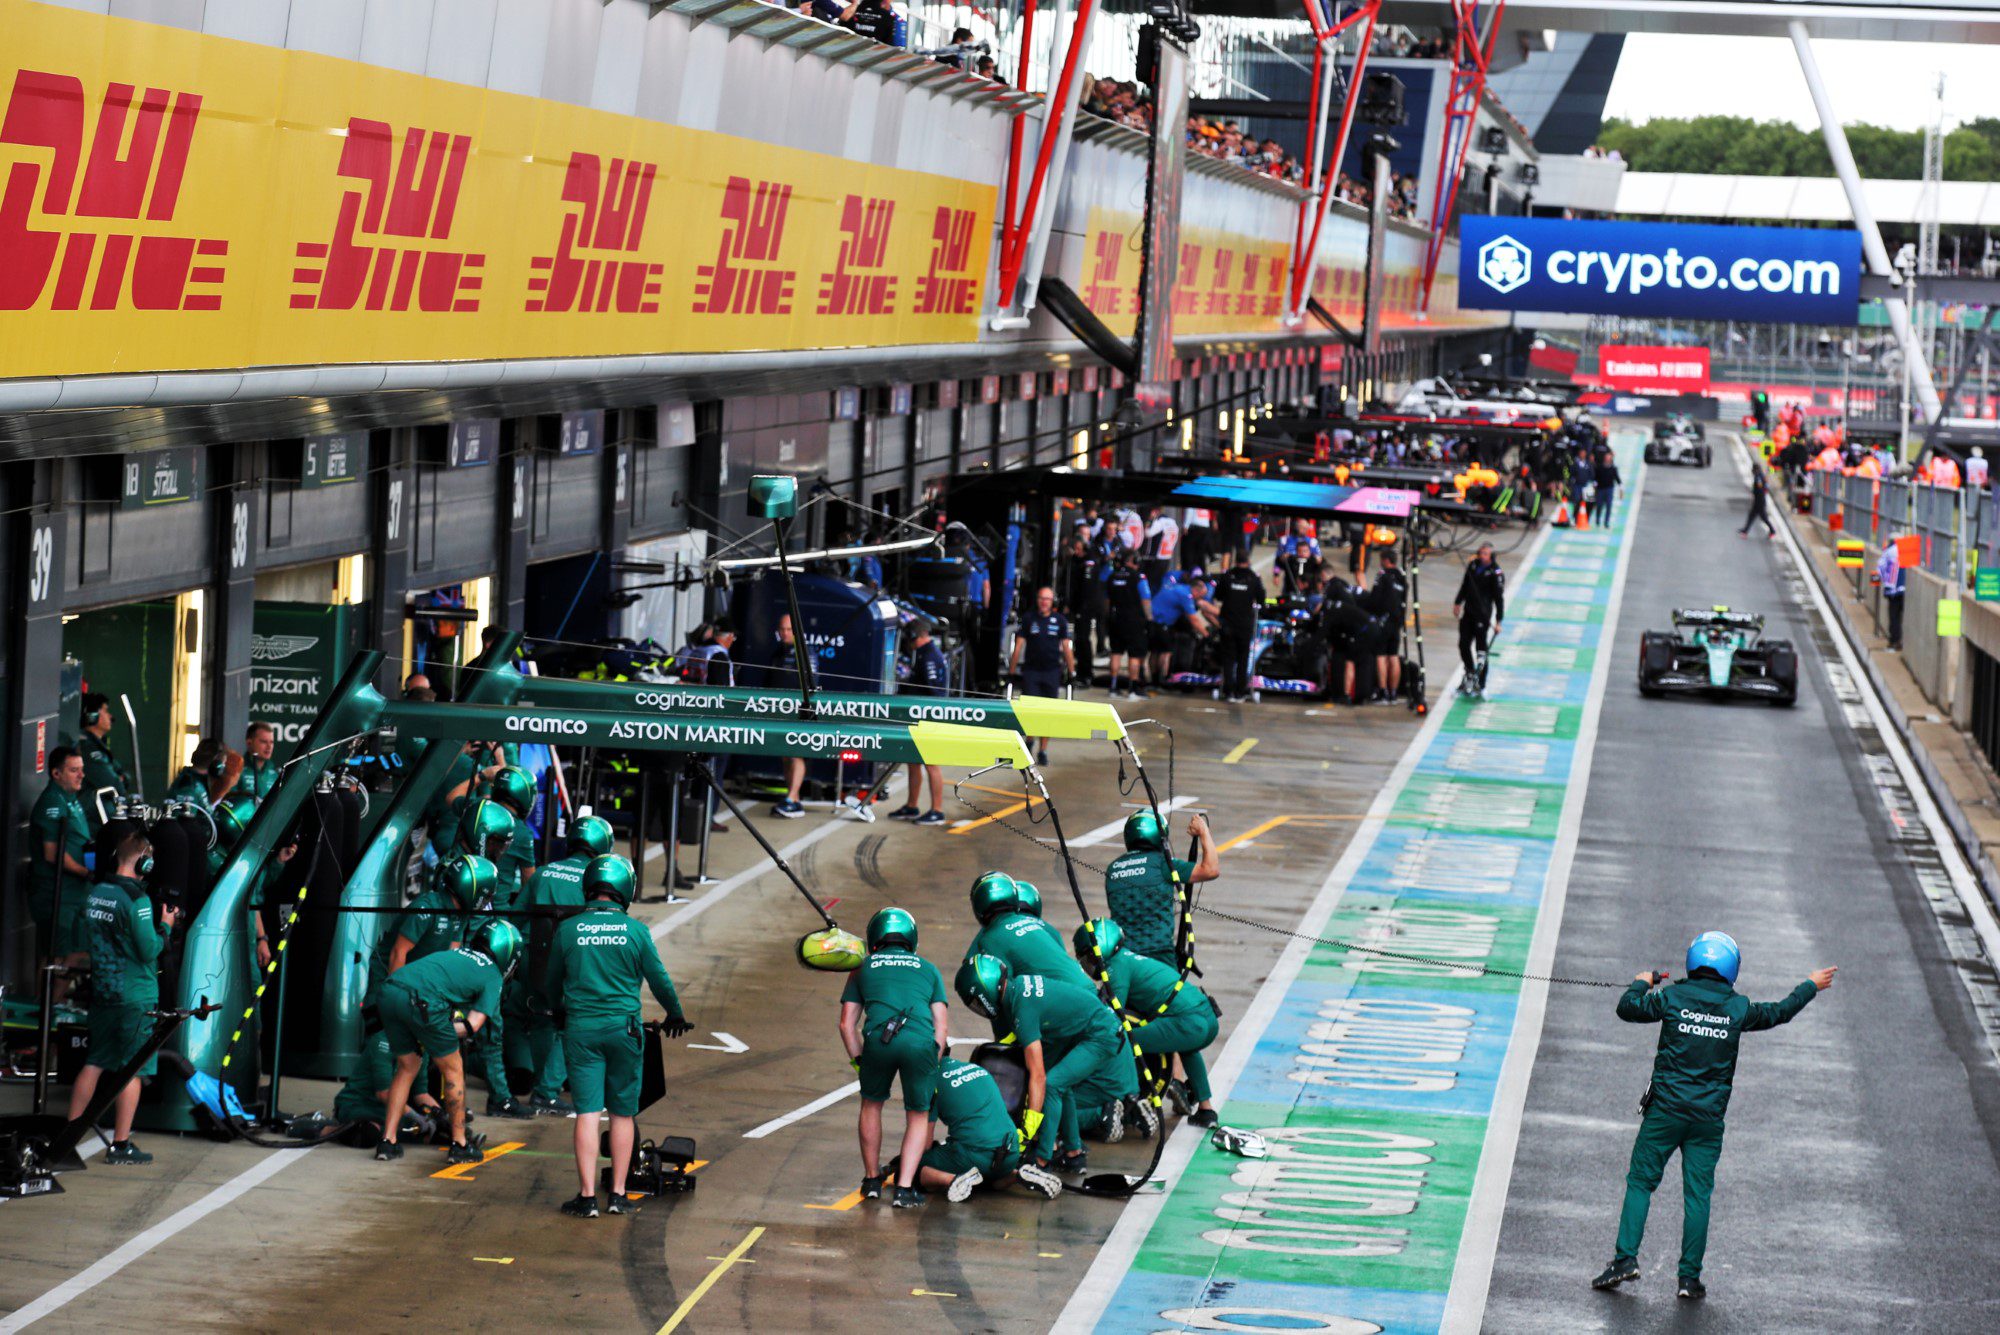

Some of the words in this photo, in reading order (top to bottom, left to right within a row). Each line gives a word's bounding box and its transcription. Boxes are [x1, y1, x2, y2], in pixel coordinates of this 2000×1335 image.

[0, 69, 229, 311] DHL
[289, 116, 486, 313] DHL
[525, 151, 664, 313] DHL
[692, 175, 796, 315] DHL
[816, 194, 898, 315] DHL
[913, 205, 978, 315] DHL
[1545, 248, 1840, 295] crypto.com
[307, 443, 317, 476] 5
[126, 463, 140, 496] 18
[152, 469, 179, 496] STROLL
[388, 480, 403, 540] 37
[231, 502, 248, 568] 38
[31, 527, 52, 602] 39
[250, 674, 320, 694] nizant
[290, 704, 318, 715] TEAM
[635, 690, 725, 711] cognizant
[815, 700, 890, 719] MARTIN
[908, 704, 986, 722] aramco
[505, 715, 588, 735] aramco
[609, 720, 679, 742] ASTON
[684, 725, 765, 746] MARTIN
[785, 730, 882, 751] cognizant
[541, 869, 580, 883] aramco
[576, 922, 628, 934] Cognizant
[576, 935, 628, 946] aramco
[871, 960, 921, 969] aramco
[1678, 1023, 1729, 1039] aramco
[1680, 1008, 1731, 1025] Cognizant
[1287, 998, 1477, 1091] aramco
